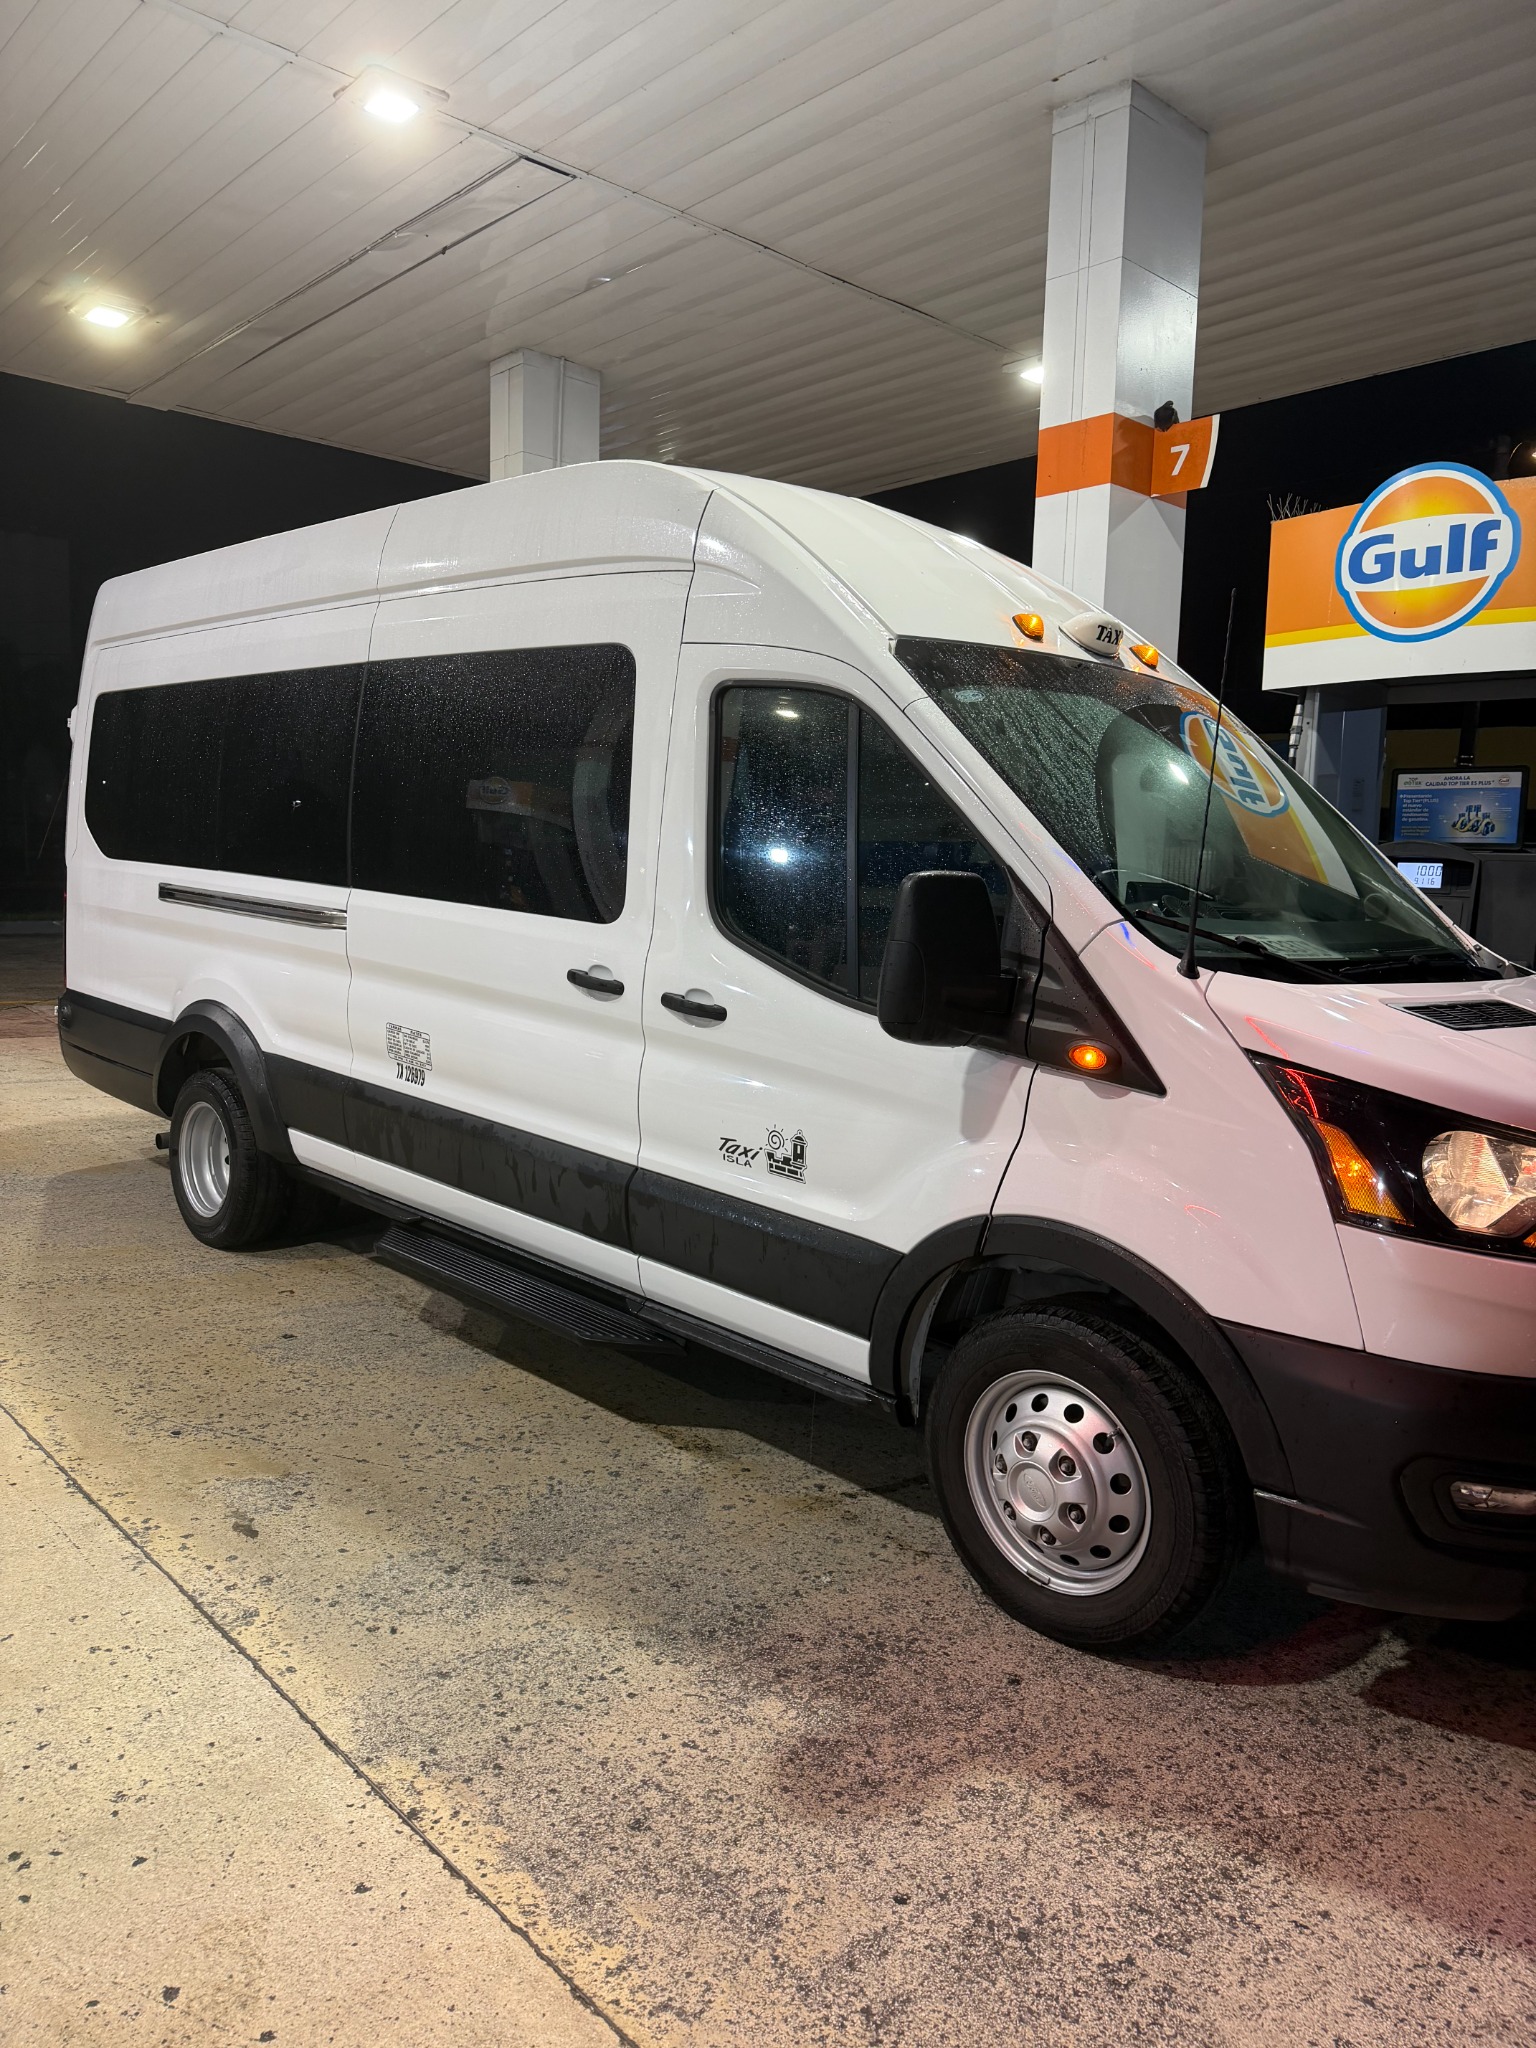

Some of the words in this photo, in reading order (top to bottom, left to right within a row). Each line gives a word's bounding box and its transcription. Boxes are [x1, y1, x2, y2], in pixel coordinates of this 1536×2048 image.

[1170, 443, 1190, 476] 7
[1348, 519, 1502, 584] Gulf
[718, 1136, 763, 1161] Taxi
[722, 1153, 752, 1168] ISLA
